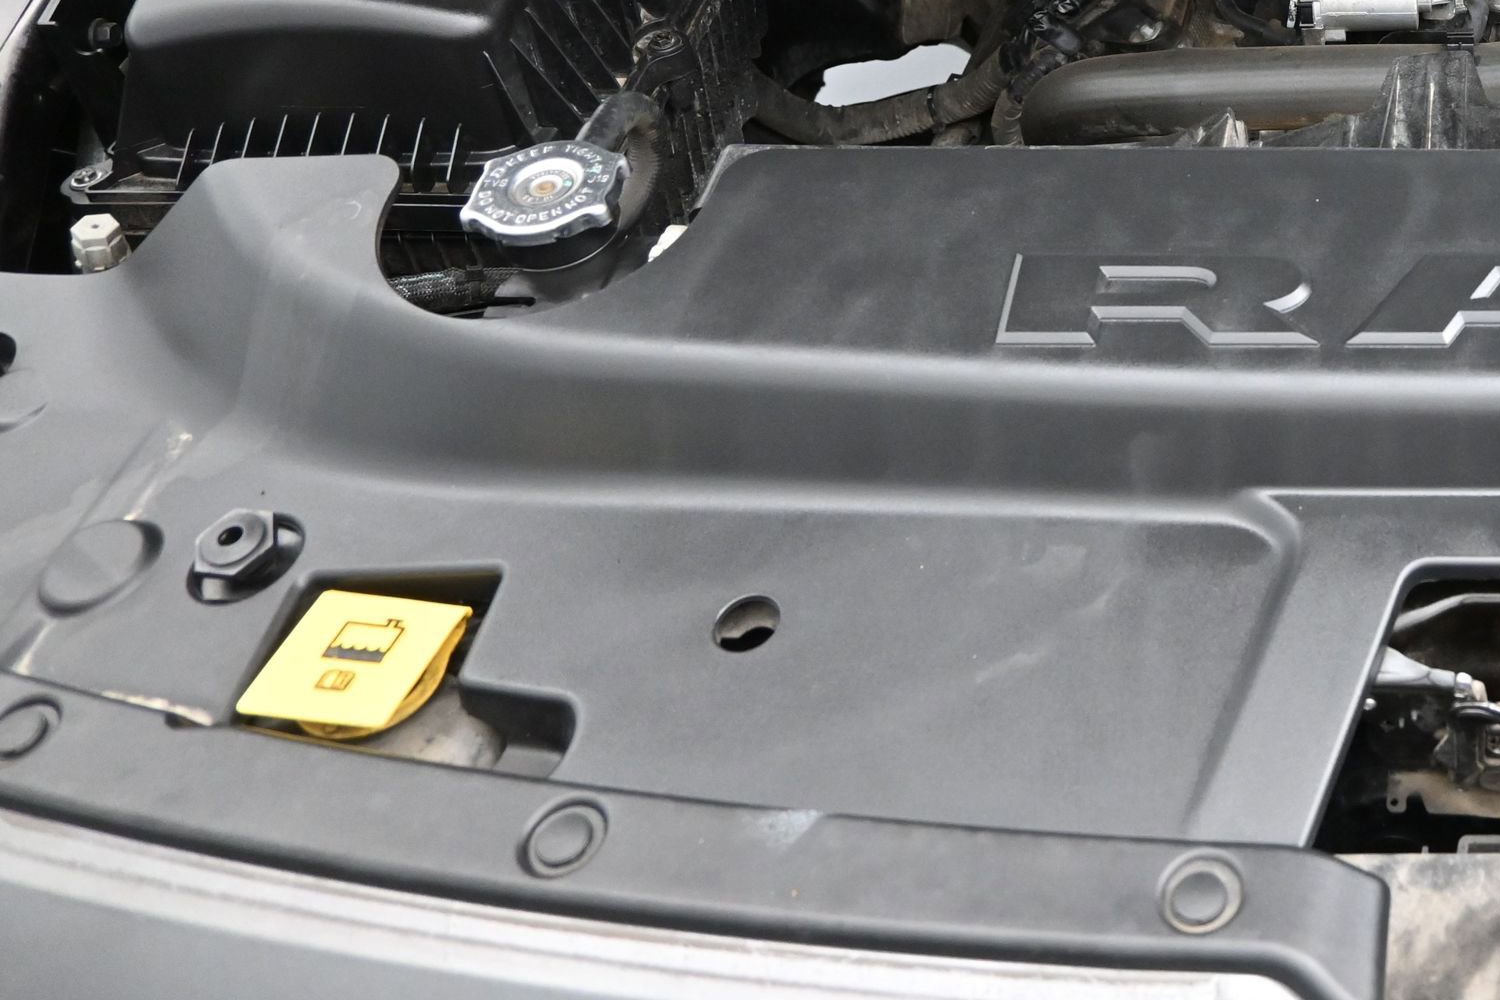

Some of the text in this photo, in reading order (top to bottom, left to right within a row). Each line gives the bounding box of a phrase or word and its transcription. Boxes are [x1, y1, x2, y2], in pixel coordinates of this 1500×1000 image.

[505, 145, 602, 168] KEEP TIGHT
[479, 187, 593, 224] DO NOT OPEN HOT
